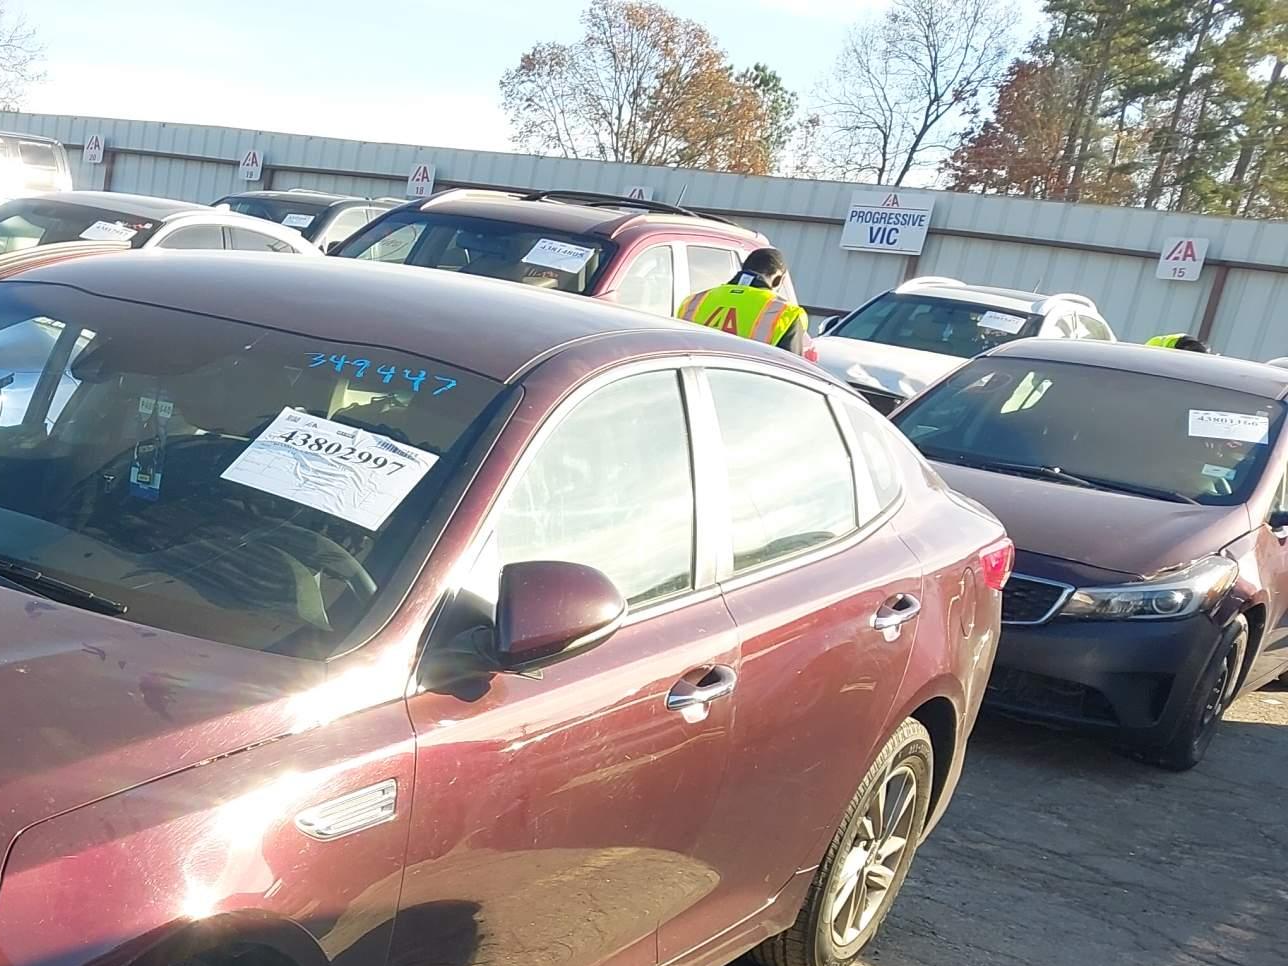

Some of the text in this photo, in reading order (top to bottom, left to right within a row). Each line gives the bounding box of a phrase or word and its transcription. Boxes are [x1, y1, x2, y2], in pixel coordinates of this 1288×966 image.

[849, 210, 926, 227] PROGRESSIVE
[869, 226, 899, 246] VIC
[1172, 267, 1186, 278] 15
[303, 352, 457, 396] 349447
[279, 430, 407, 476] 43802997
